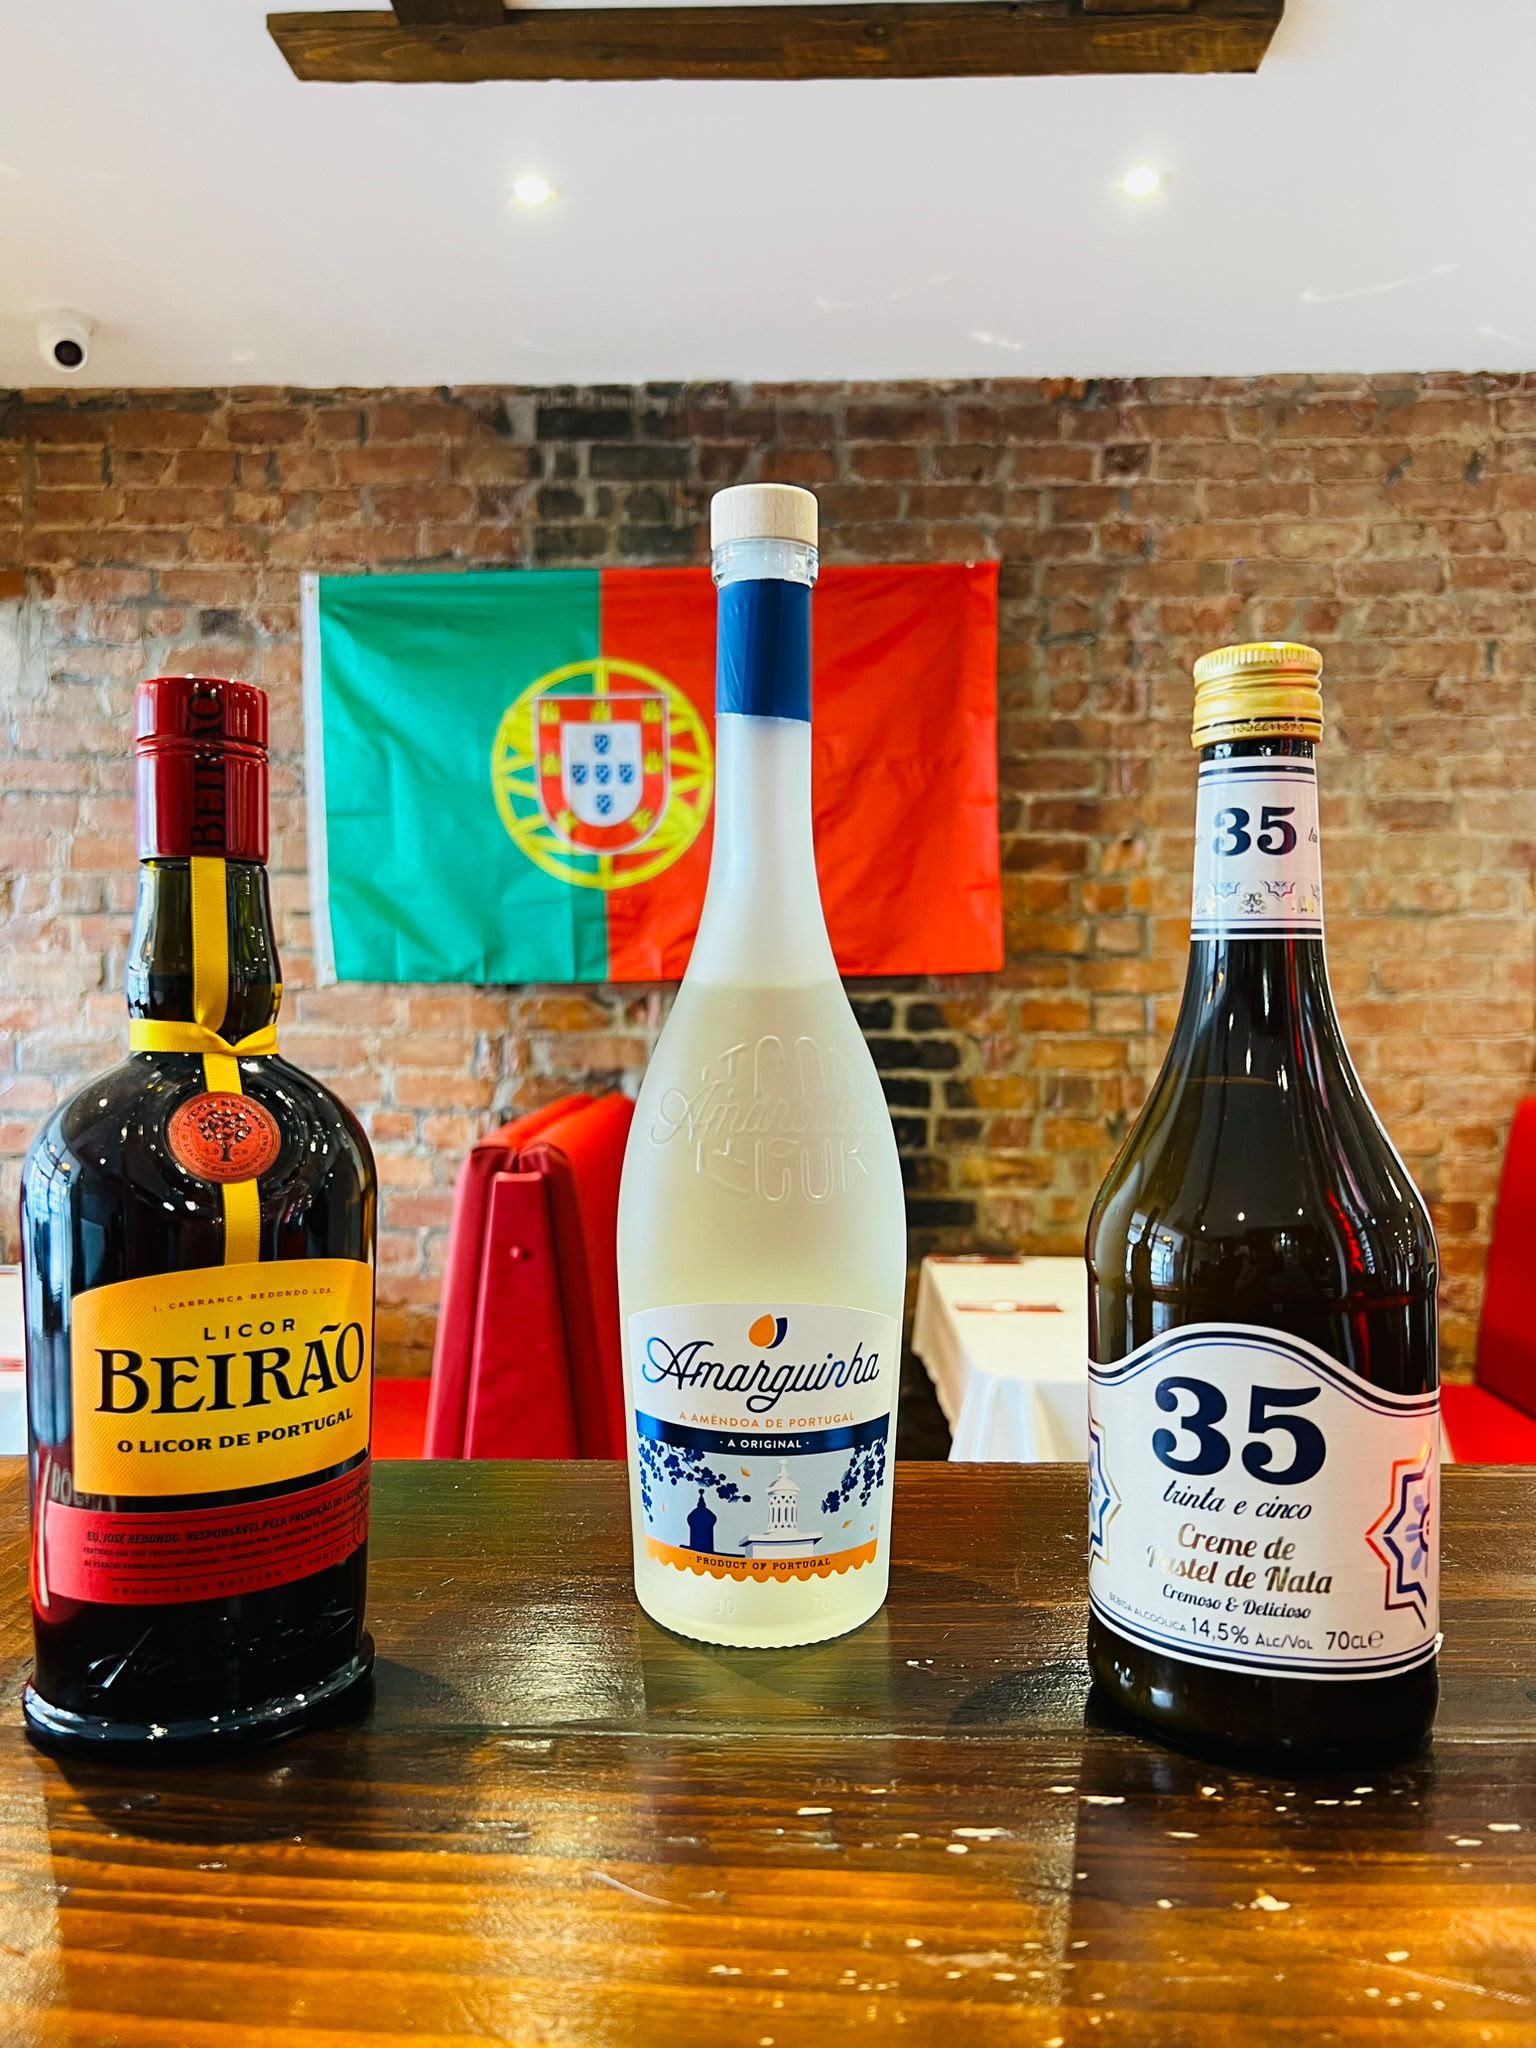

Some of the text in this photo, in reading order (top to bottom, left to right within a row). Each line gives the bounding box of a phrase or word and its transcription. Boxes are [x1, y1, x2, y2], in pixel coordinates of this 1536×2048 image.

[1213, 806, 1297, 856] 35
[169, 1295, 243, 1310] CARRANCA
[251, 1289, 308, 1300] REDONDO
[203, 1318, 296, 1341] LICOR
[95, 1322, 364, 1414] BEIRÃO
[642, 1337, 880, 1413] Amarguinha
[117, 1408, 353, 1453] O LICOR DE PORTUGAL
[680, 1412, 854, 1428] A AMÊNDOA DE PORTUGAL
[1152, 1376, 1326, 1486] 35
[728, 1439, 802, 1449] A ORIGINAL
[1163, 1480, 1312, 1519] trinta e cinco
[1178, 1523, 1296, 1561] Creme de
[696, 1556, 831, 1570] PRODUCT OF PORTUGAL
[1225, 1564, 1256, 1589] de
[1265, 1566, 1333, 1594] Nata
[1163, 1584, 1311, 1619] Cremoso & Delicioso
[1192, 1617, 1249, 1645] 14,5%
